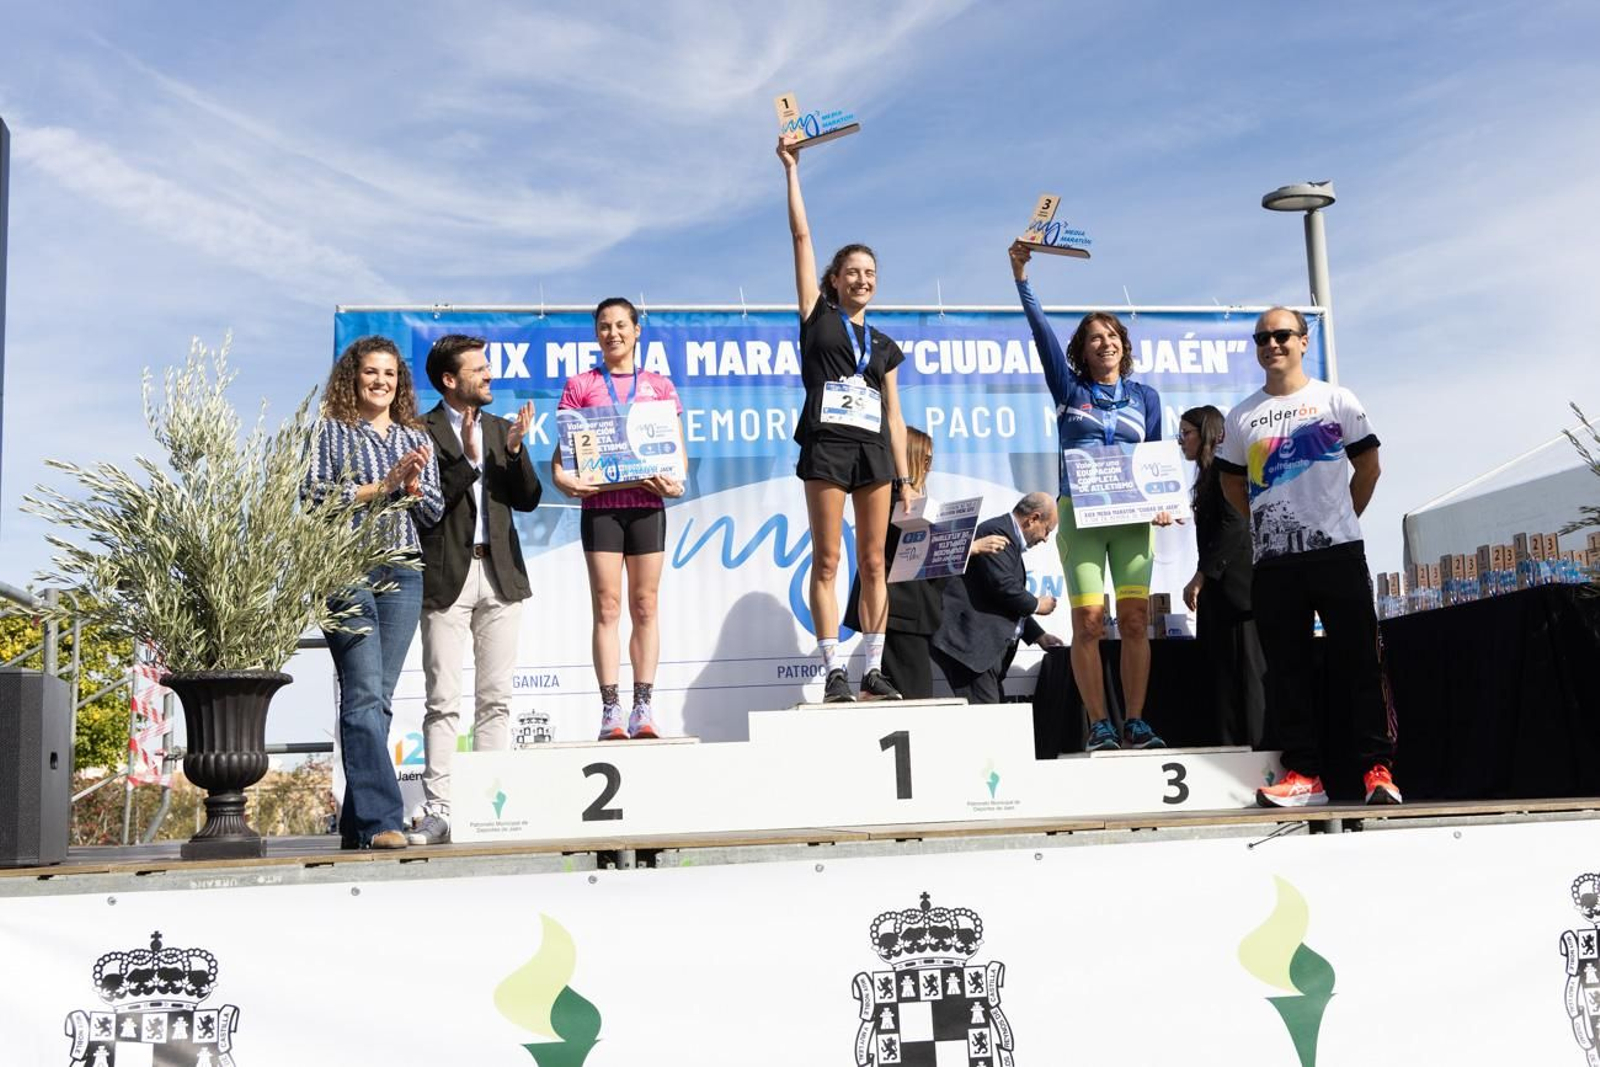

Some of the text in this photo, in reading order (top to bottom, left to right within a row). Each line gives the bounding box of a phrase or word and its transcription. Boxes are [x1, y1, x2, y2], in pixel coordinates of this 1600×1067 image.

[782, 98, 789, 108] 1
[1042, 198, 1052, 210] 3
[546, 341, 671, 379] MEIA
[686, 341, 801, 376] MARA
[895, 340, 1045, 375] "CIUDA
[688, 409, 797, 441] EMORI
[925, 406, 1016, 439] PACO
[1250, 403, 1318, 428] calderón
[581, 434, 592, 447] 2
[1091, 481, 1133, 492] ATLETISMO
[512, 674, 560, 689] GANIZA
[879, 730, 912, 800] 1
[582, 762, 623, 821] 2
[1161, 762, 1189, 804] 3
[989, 969, 997, 1003] CASTILLA
[220, 1013, 230, 1048] CASTILLA
[992, 1008, 1010, 1048] REYNOS DE
